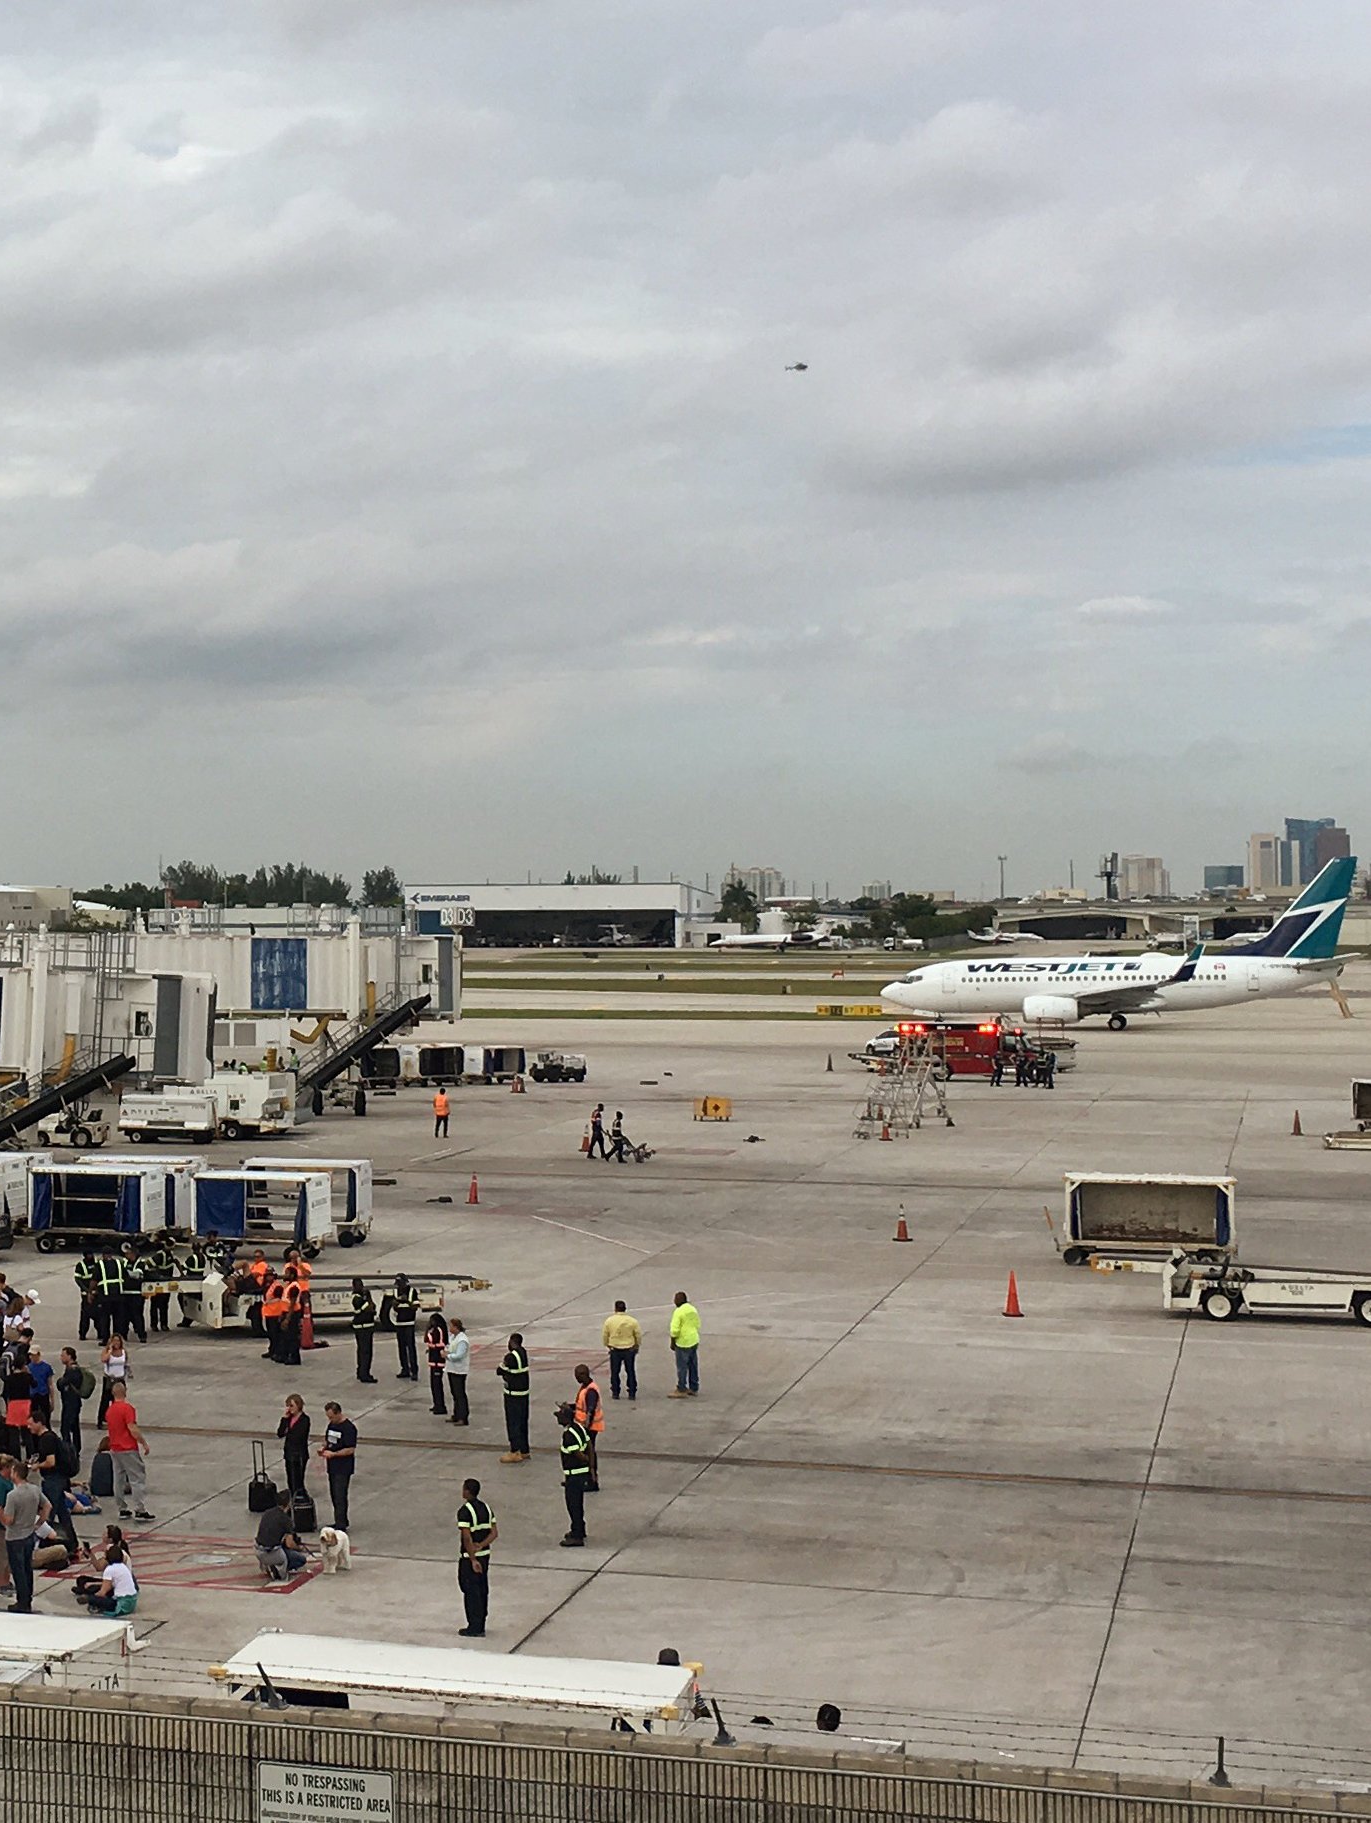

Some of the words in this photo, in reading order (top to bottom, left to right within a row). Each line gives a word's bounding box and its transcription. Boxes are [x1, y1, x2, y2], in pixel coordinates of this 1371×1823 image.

[420, 894, 471, 902] EMBRAER
[440, 908, 454, 926] D3
[458, 908, 474, 925] D3
[967, 962, 1124, 975] WESTJET
[285, 1773, 299, 1787] NO
[302, 1774, 366, 1792] TRESPASSING
[262, 1788, 282, 1803] THIS
[285, 1790, 295, 1805] IS
[297, 1792, 304, 1806] A
[306, 1793, 363, 1811] RESTRICTED
[366, 1799, 391, 1813] AREA
